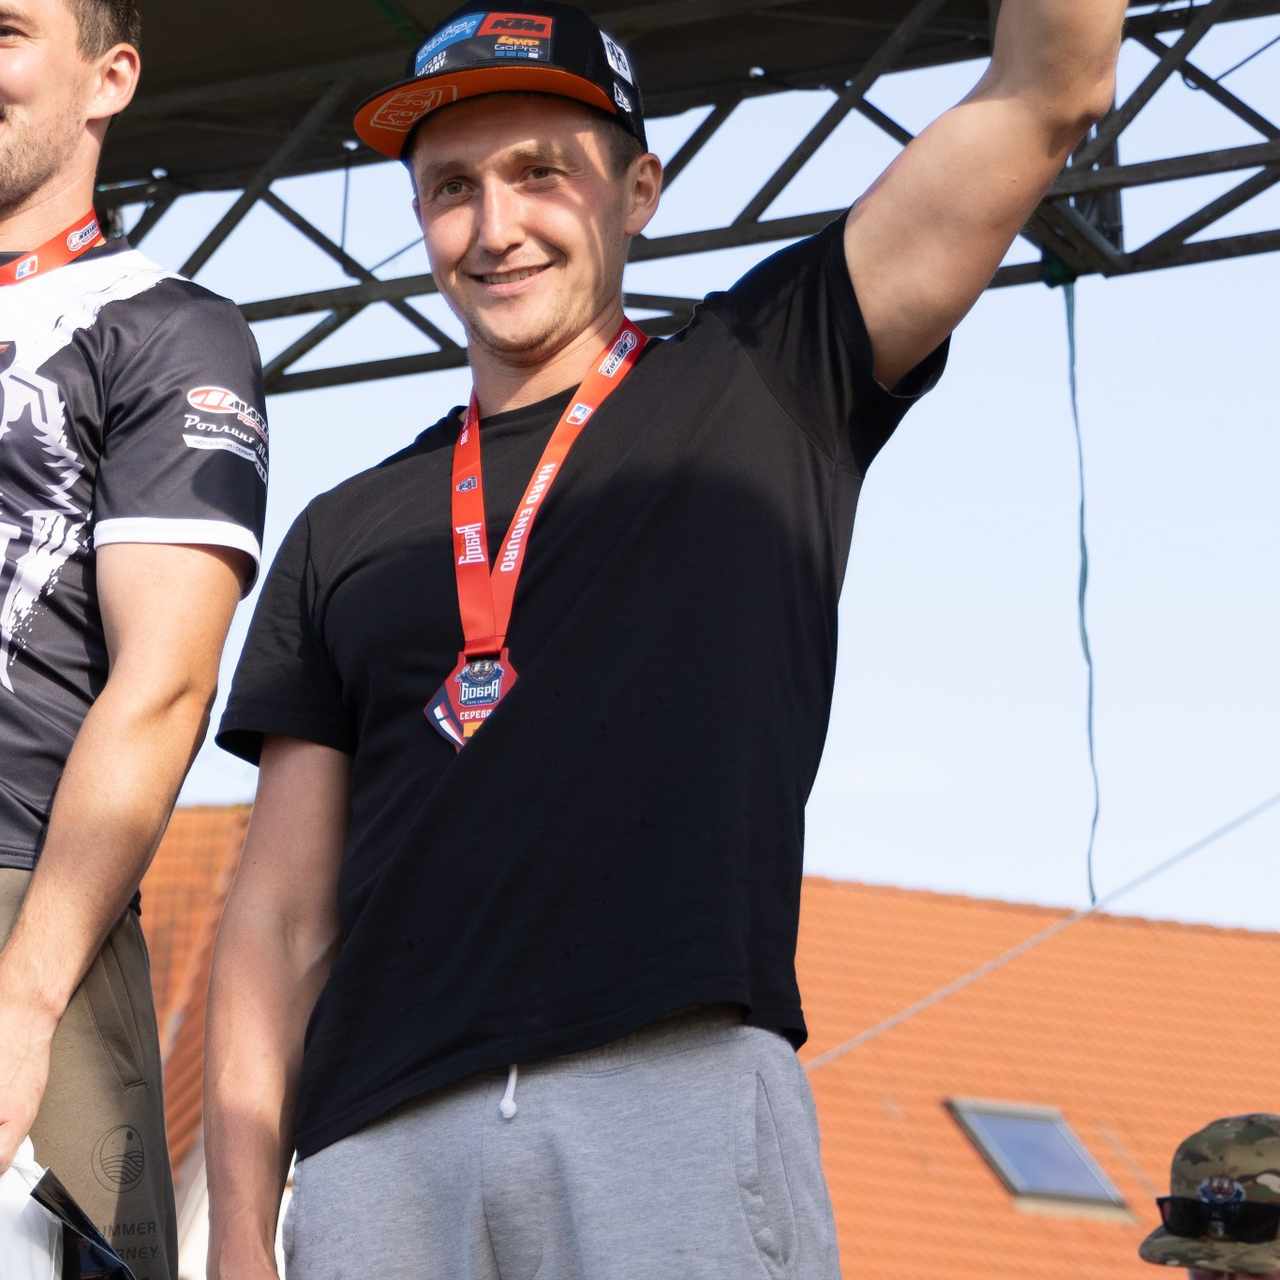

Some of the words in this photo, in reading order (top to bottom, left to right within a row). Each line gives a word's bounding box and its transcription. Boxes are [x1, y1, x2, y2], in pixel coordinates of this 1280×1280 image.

[490, 17, 547, 33] KTM
[494, 44, 539, 52] GoPro
[525, 463, 556, 505] HARD
[455, 522, 486, 565] БОБРА
[500, 507, 534, 572] ENDURO
[461, 679, 500, 702] БОБРА
[460, 709, 493, 720] СЕРЕБР
